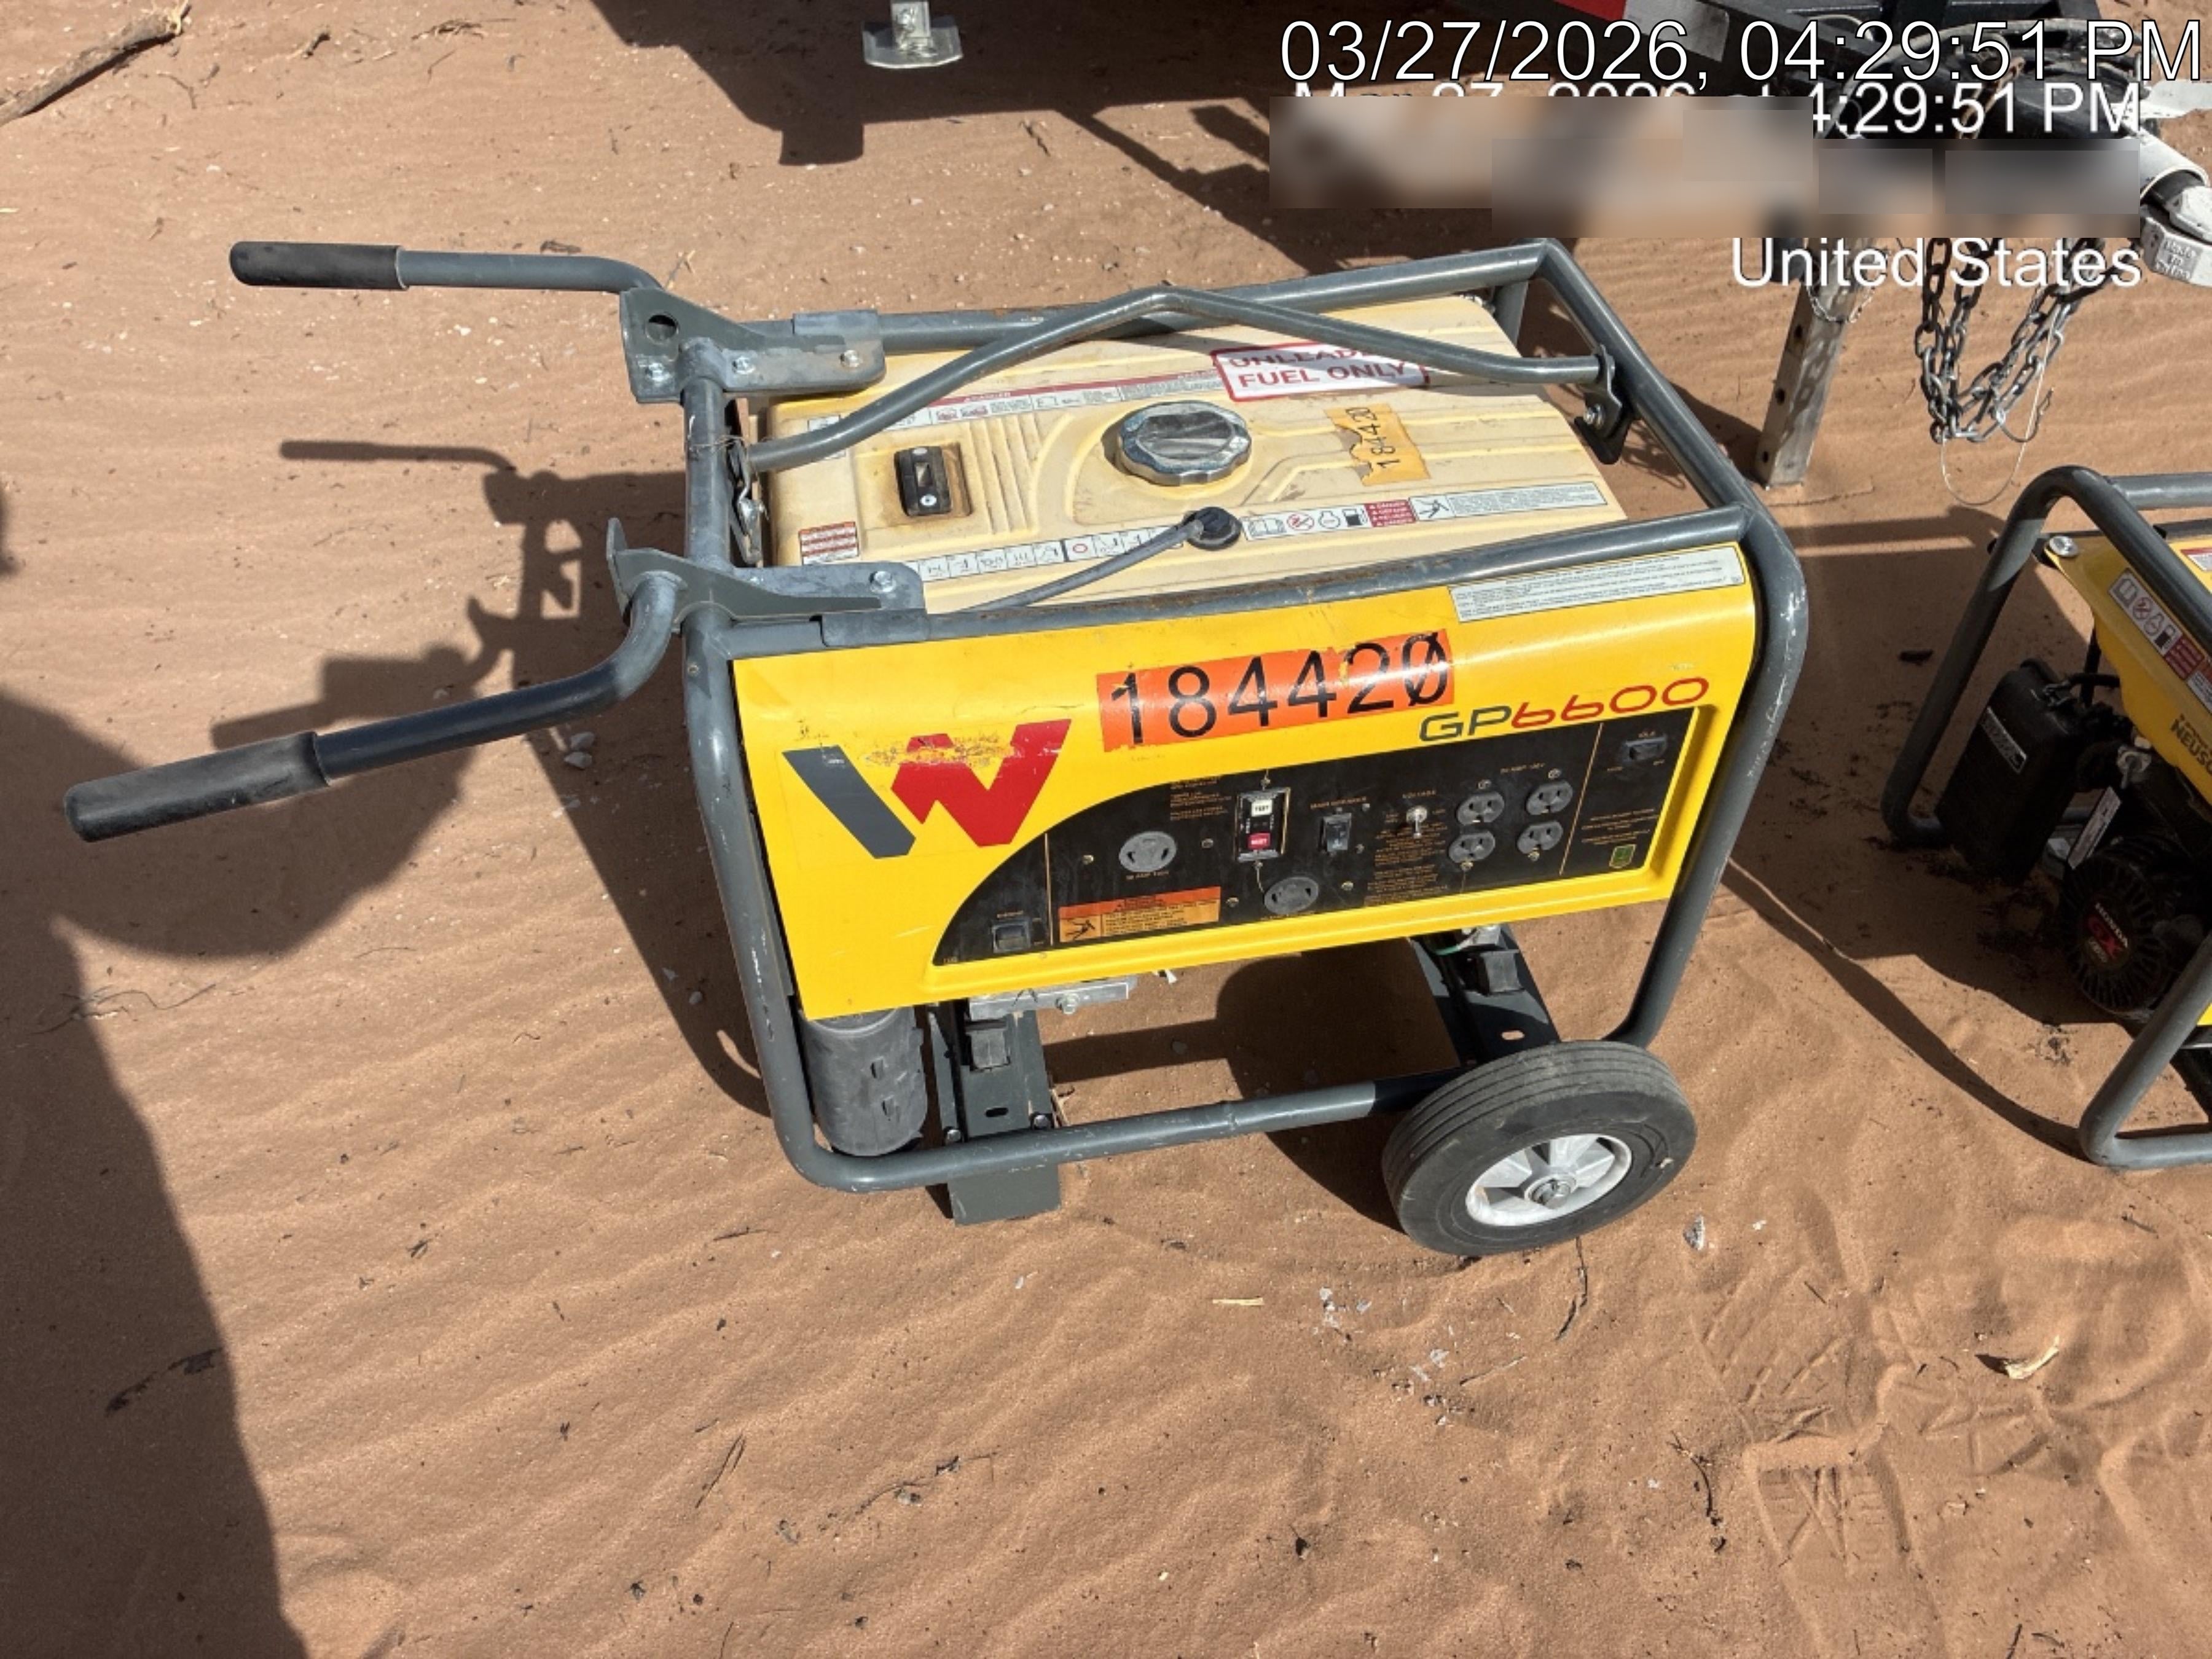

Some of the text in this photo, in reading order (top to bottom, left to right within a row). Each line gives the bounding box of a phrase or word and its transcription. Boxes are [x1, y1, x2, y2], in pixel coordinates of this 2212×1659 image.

[1238, 367, 1320, 388] FUEL
[1327, 362, 1405, 380] ONLY
[1111, 632, 1449, 745] 184420
[1419, 677, 1709, 742] GP6600
